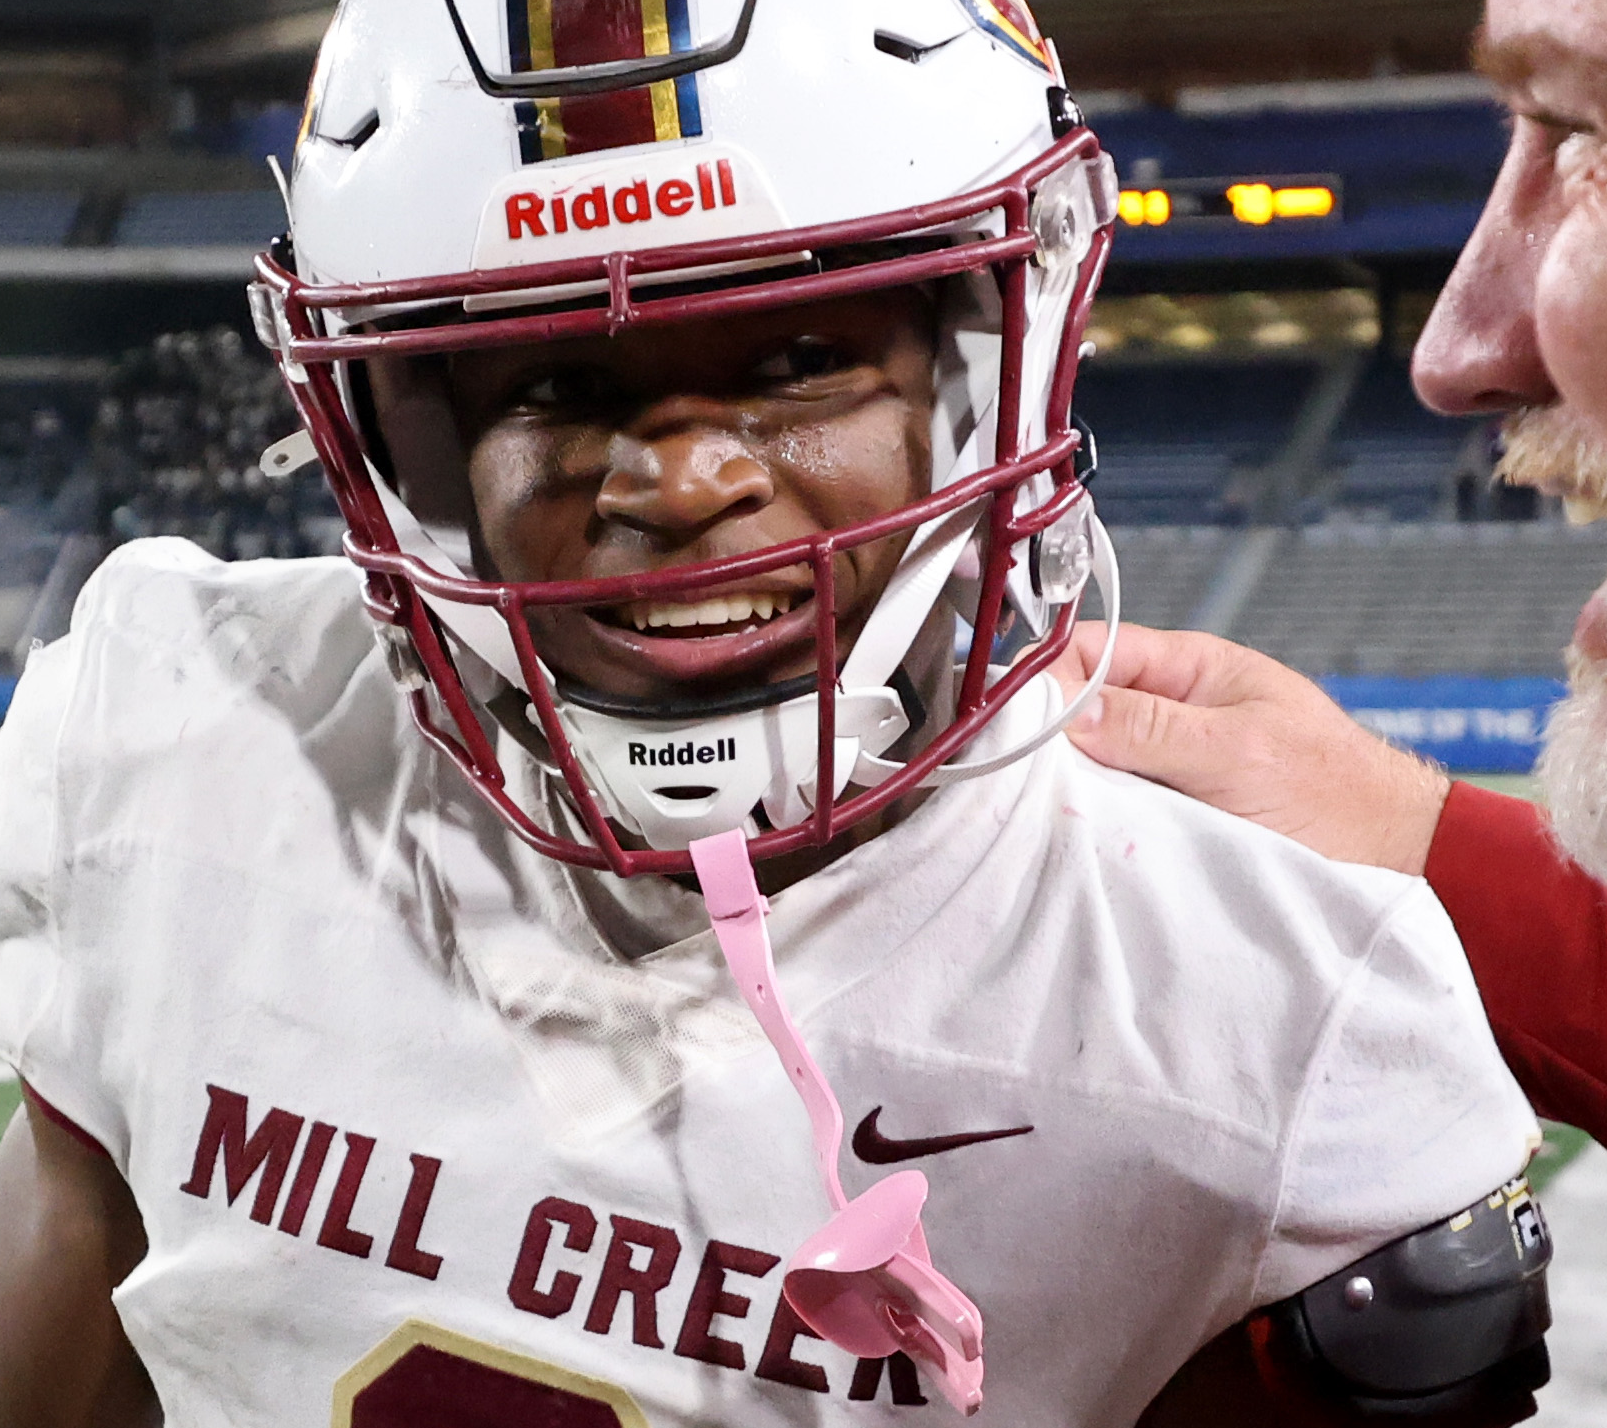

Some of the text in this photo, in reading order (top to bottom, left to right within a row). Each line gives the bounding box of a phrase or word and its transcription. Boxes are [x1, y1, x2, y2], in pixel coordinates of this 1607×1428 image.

[504, 158, 738, 240] Riddell
[627, 736, 737, 767] Riddell
[179, 1082, 444, 1281] MILL
